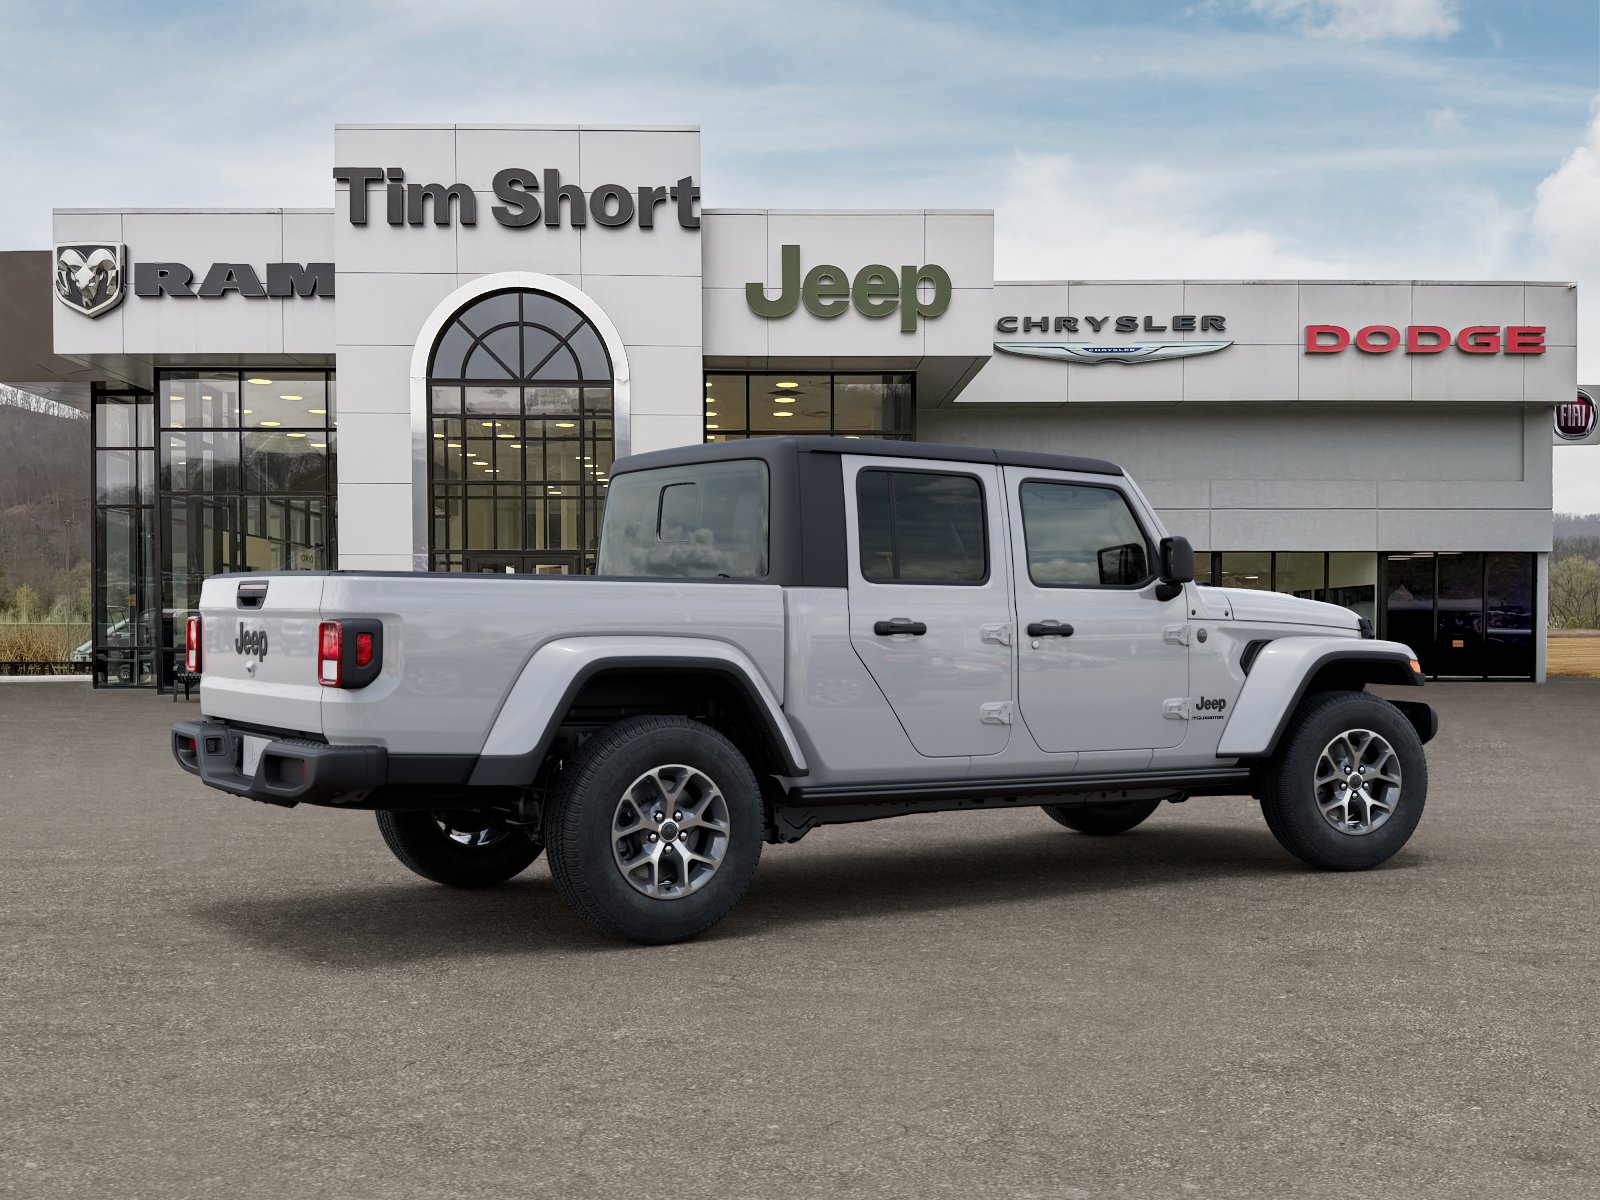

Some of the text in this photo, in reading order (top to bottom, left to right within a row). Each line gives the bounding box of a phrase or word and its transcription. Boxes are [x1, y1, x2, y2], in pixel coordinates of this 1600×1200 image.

[333, 167, 701, 228] Tim Short
[134, 262, 336, 299] RAM
[745, 244, 953, 333] Jeep
[997, 315, 1227, 333] CHRYSLER
[1304, 325, 1547, 355] DODGE
[1560, 404, 1586, 427] FIAT
[235, 621, 268, 663] Jeep
[1195, 696, 1226, 712] Jeep
